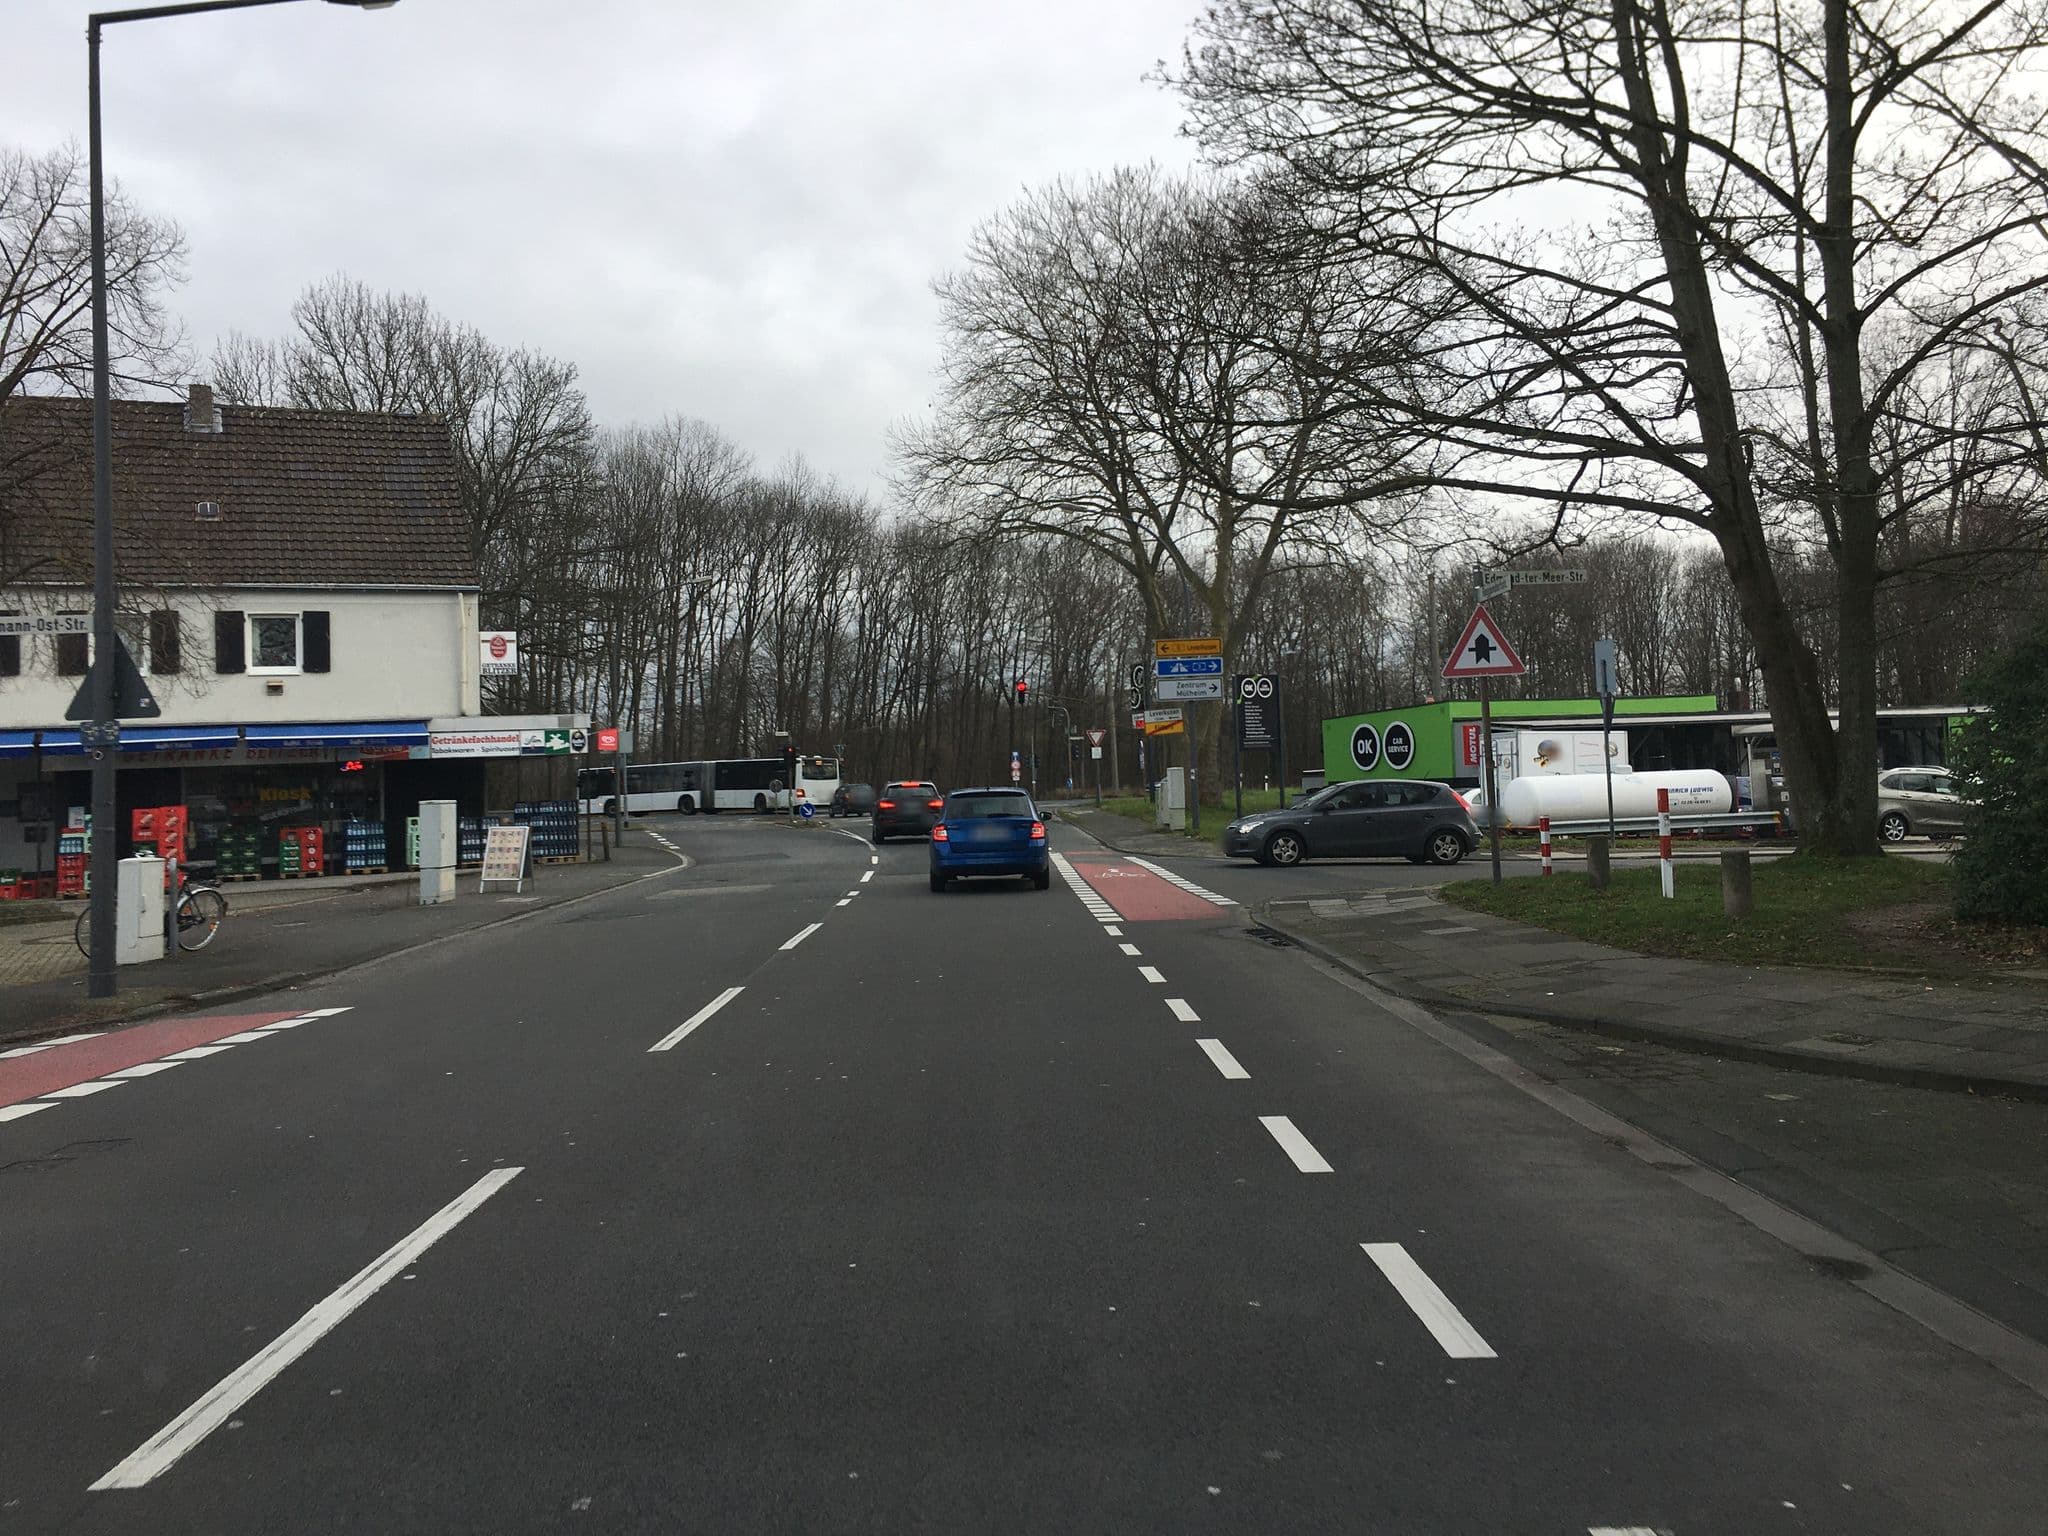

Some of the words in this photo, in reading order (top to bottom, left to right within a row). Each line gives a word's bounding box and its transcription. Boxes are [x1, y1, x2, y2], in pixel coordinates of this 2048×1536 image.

[1484, 571, 1585, 585] Edmnd-ter-Meer-Str.
[431, 734, 520, 745] Getränkefachhandel
[1392, 737, 1403, 745] CAR
[1469, 727, 1478, 763] MOTUL
[1357, 739, 1373, 754] OK
[1388, 745, 1409, 753] SERVICE
